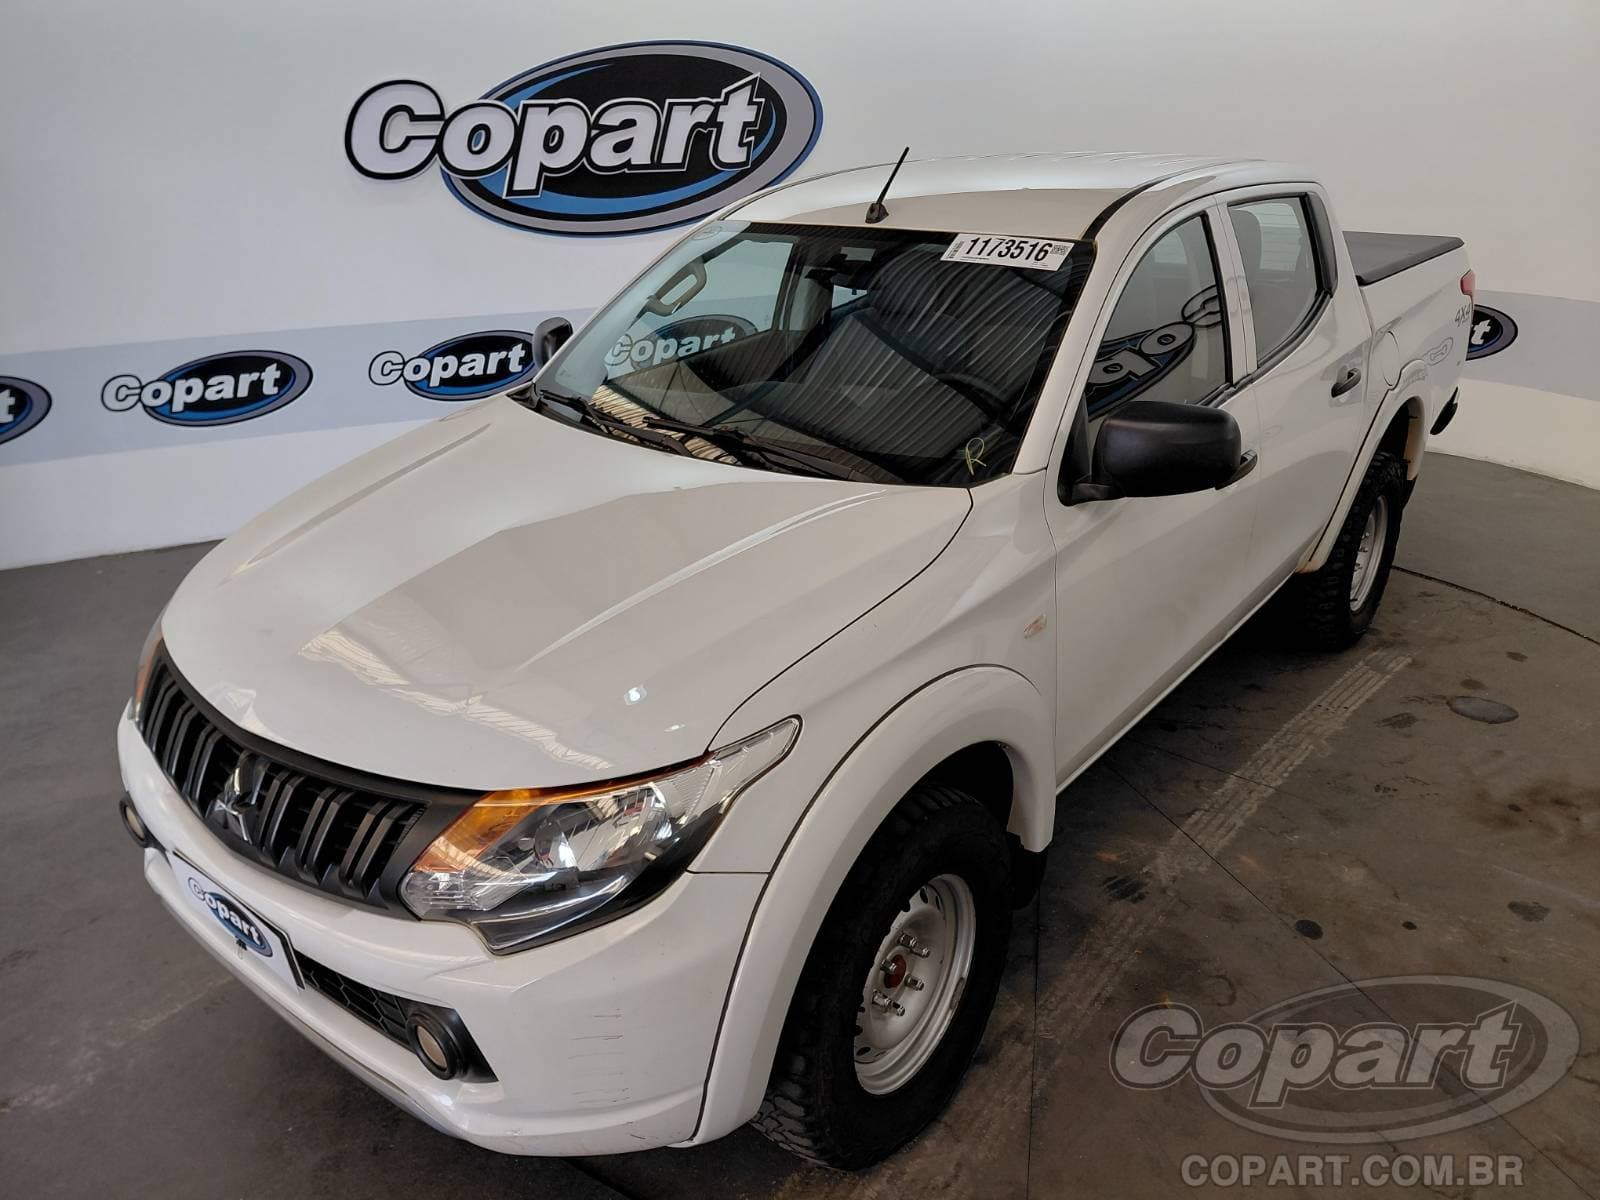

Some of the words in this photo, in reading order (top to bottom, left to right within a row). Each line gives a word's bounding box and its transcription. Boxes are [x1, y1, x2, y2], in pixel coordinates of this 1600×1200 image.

[345, 73, 765, 198] Copart
[966, 237, 1053, 262] 1173516
[102, 361, 282, 413] Copart
[369, 341, 527, 388] Copart
[965, 437, 987, 476] R
[187, 876, 264, 947] Copart
